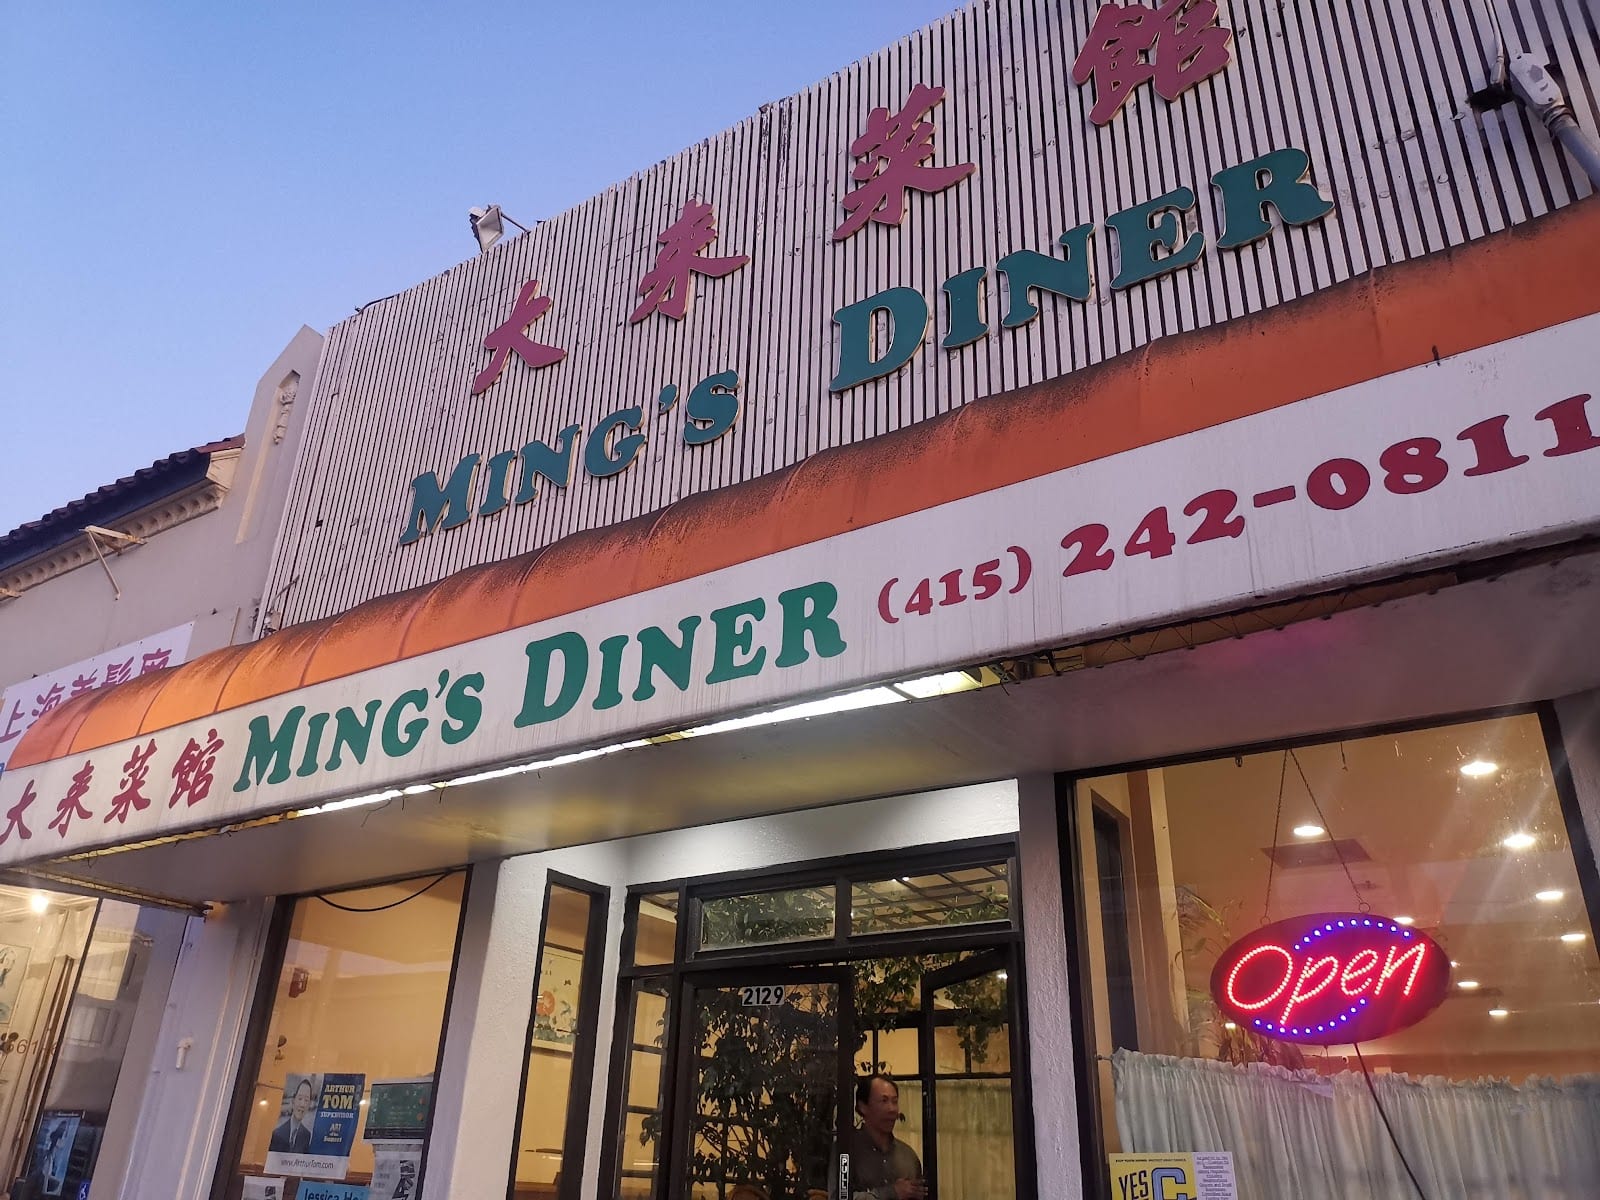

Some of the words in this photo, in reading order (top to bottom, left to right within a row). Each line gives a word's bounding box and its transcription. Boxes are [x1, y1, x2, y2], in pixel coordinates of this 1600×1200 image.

[400, 370, 740, 545] MING'S
[829, 147, 1335, 393] DINER
[233, 669, 485, 792] MING'S
[513, 581, 847, 728] DINER
[877, 546, 1032, 624] (415)
[1061, 394, 1600, 578] 242-0811
[744, 986, 784, 1005] 2129
[1227, 943, 1426, 1025] Open
[323, 1094, 353, 1109] TOM
[324, 1084, 355, 1093] ARTHUR
[1118, 1169, 1149, 1200] YES
